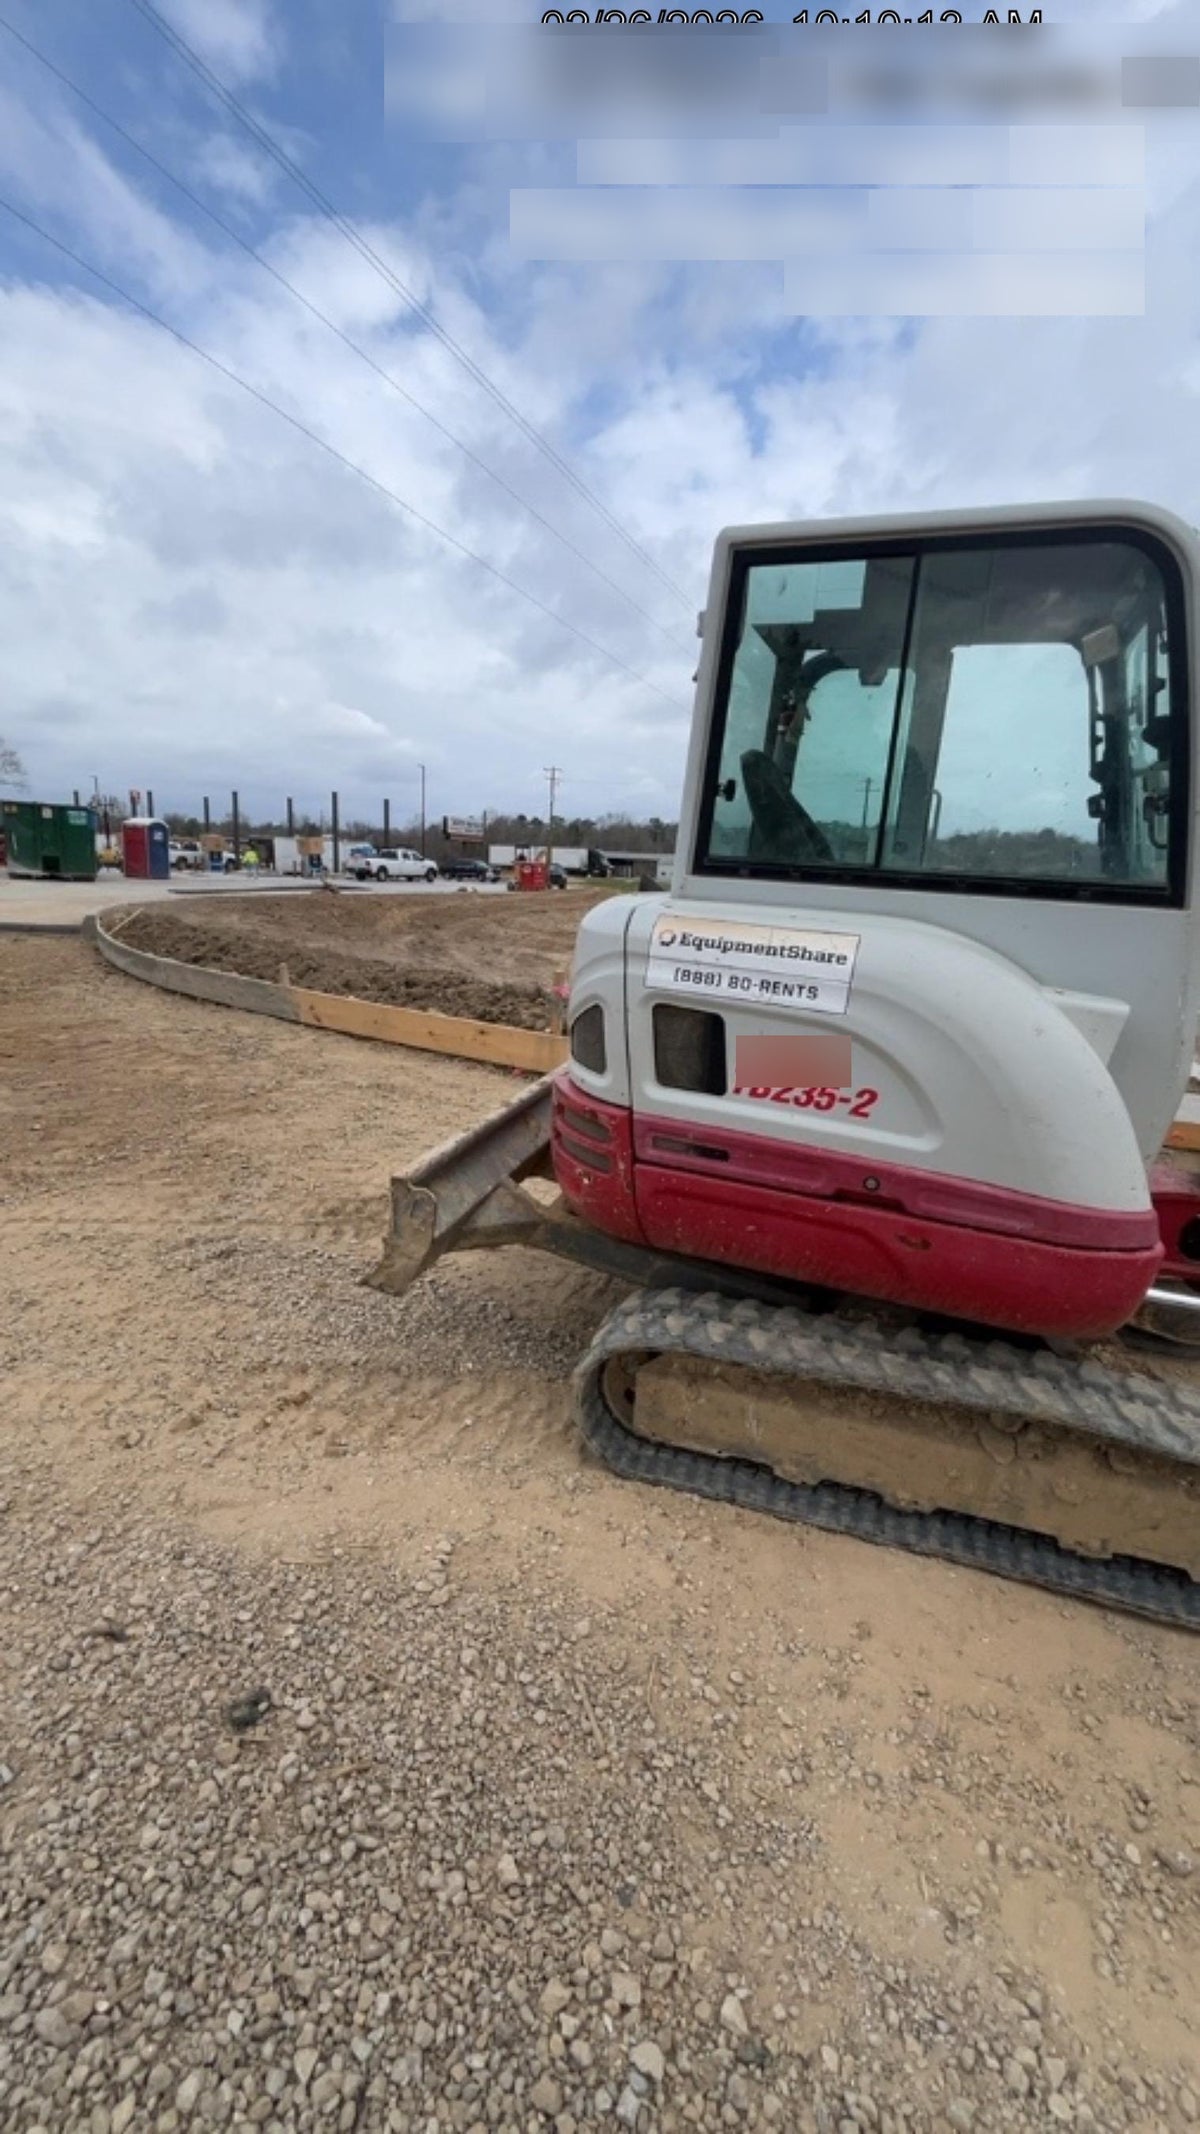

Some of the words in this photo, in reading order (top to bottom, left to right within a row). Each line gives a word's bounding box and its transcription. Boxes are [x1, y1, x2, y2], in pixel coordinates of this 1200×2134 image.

[679, 931, 848, 965] EquipmentShare
[673, 967, 722, 987] (888)
[728, 974, 819, 1000] 80-RENTS
[732, 1087, 878, 1118] 235-2
